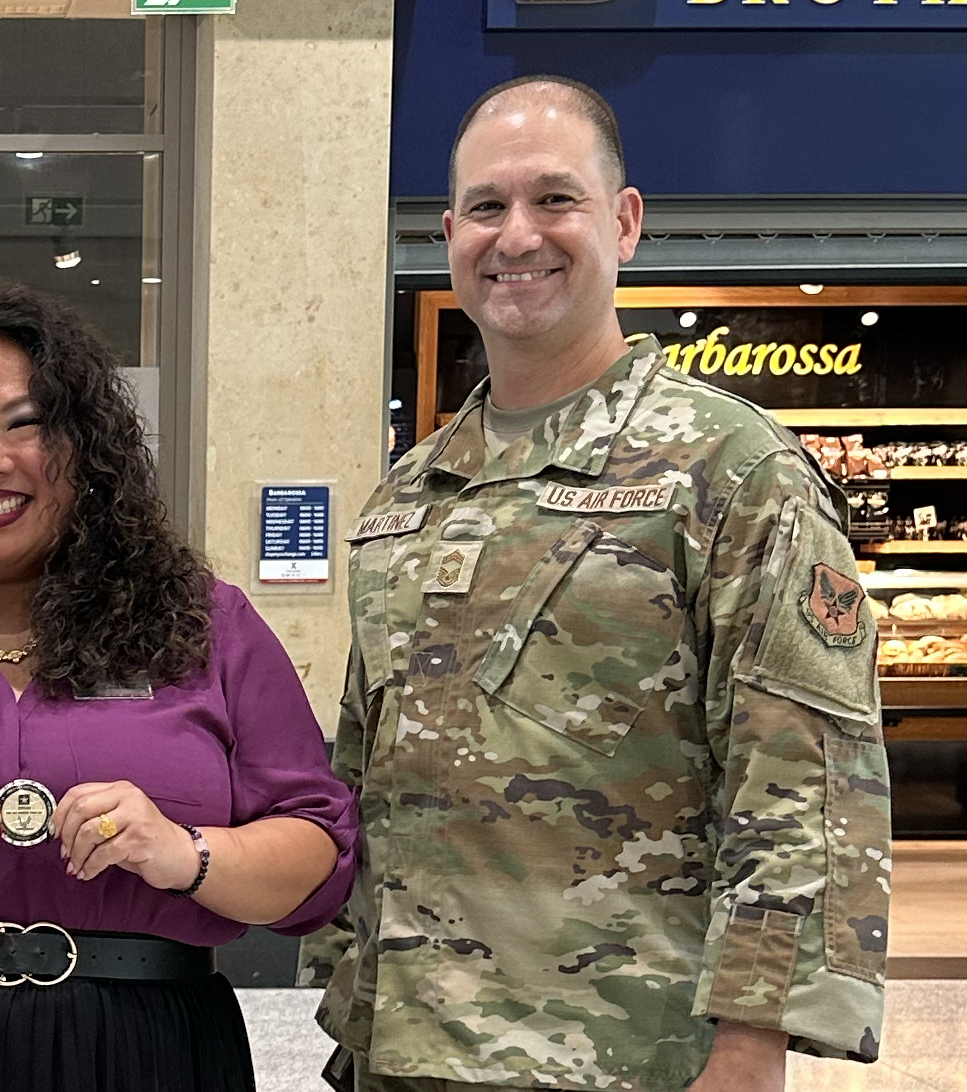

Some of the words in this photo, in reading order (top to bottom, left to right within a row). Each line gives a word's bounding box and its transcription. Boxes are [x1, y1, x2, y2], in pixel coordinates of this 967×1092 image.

[624, 326, 862, 376] arbarossa
[577, 491, 609, 509] AIR
[609, 488, 667, 508] FORCE
